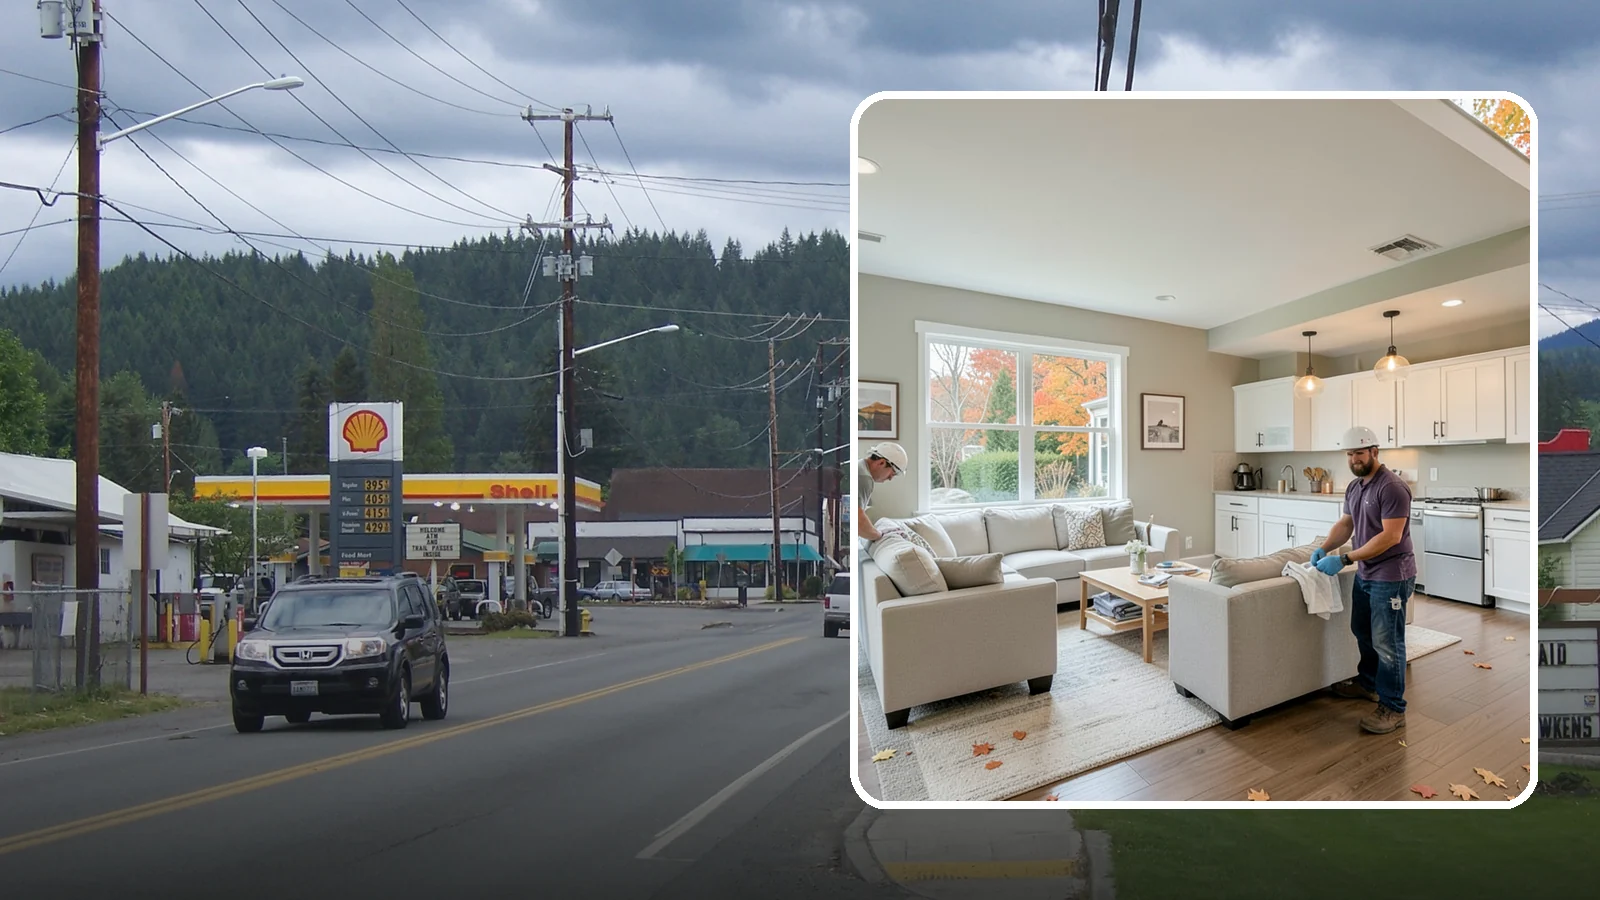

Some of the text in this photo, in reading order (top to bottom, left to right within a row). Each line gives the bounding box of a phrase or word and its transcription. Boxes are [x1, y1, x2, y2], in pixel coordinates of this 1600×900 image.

[342, 480, 383, 490] Regular 395
[490, 484, 547, 499] Shell
[366, 494, 383, 504] 405
[366, 508, 383, 518] 415
[366, 523, 383, 532] 429
